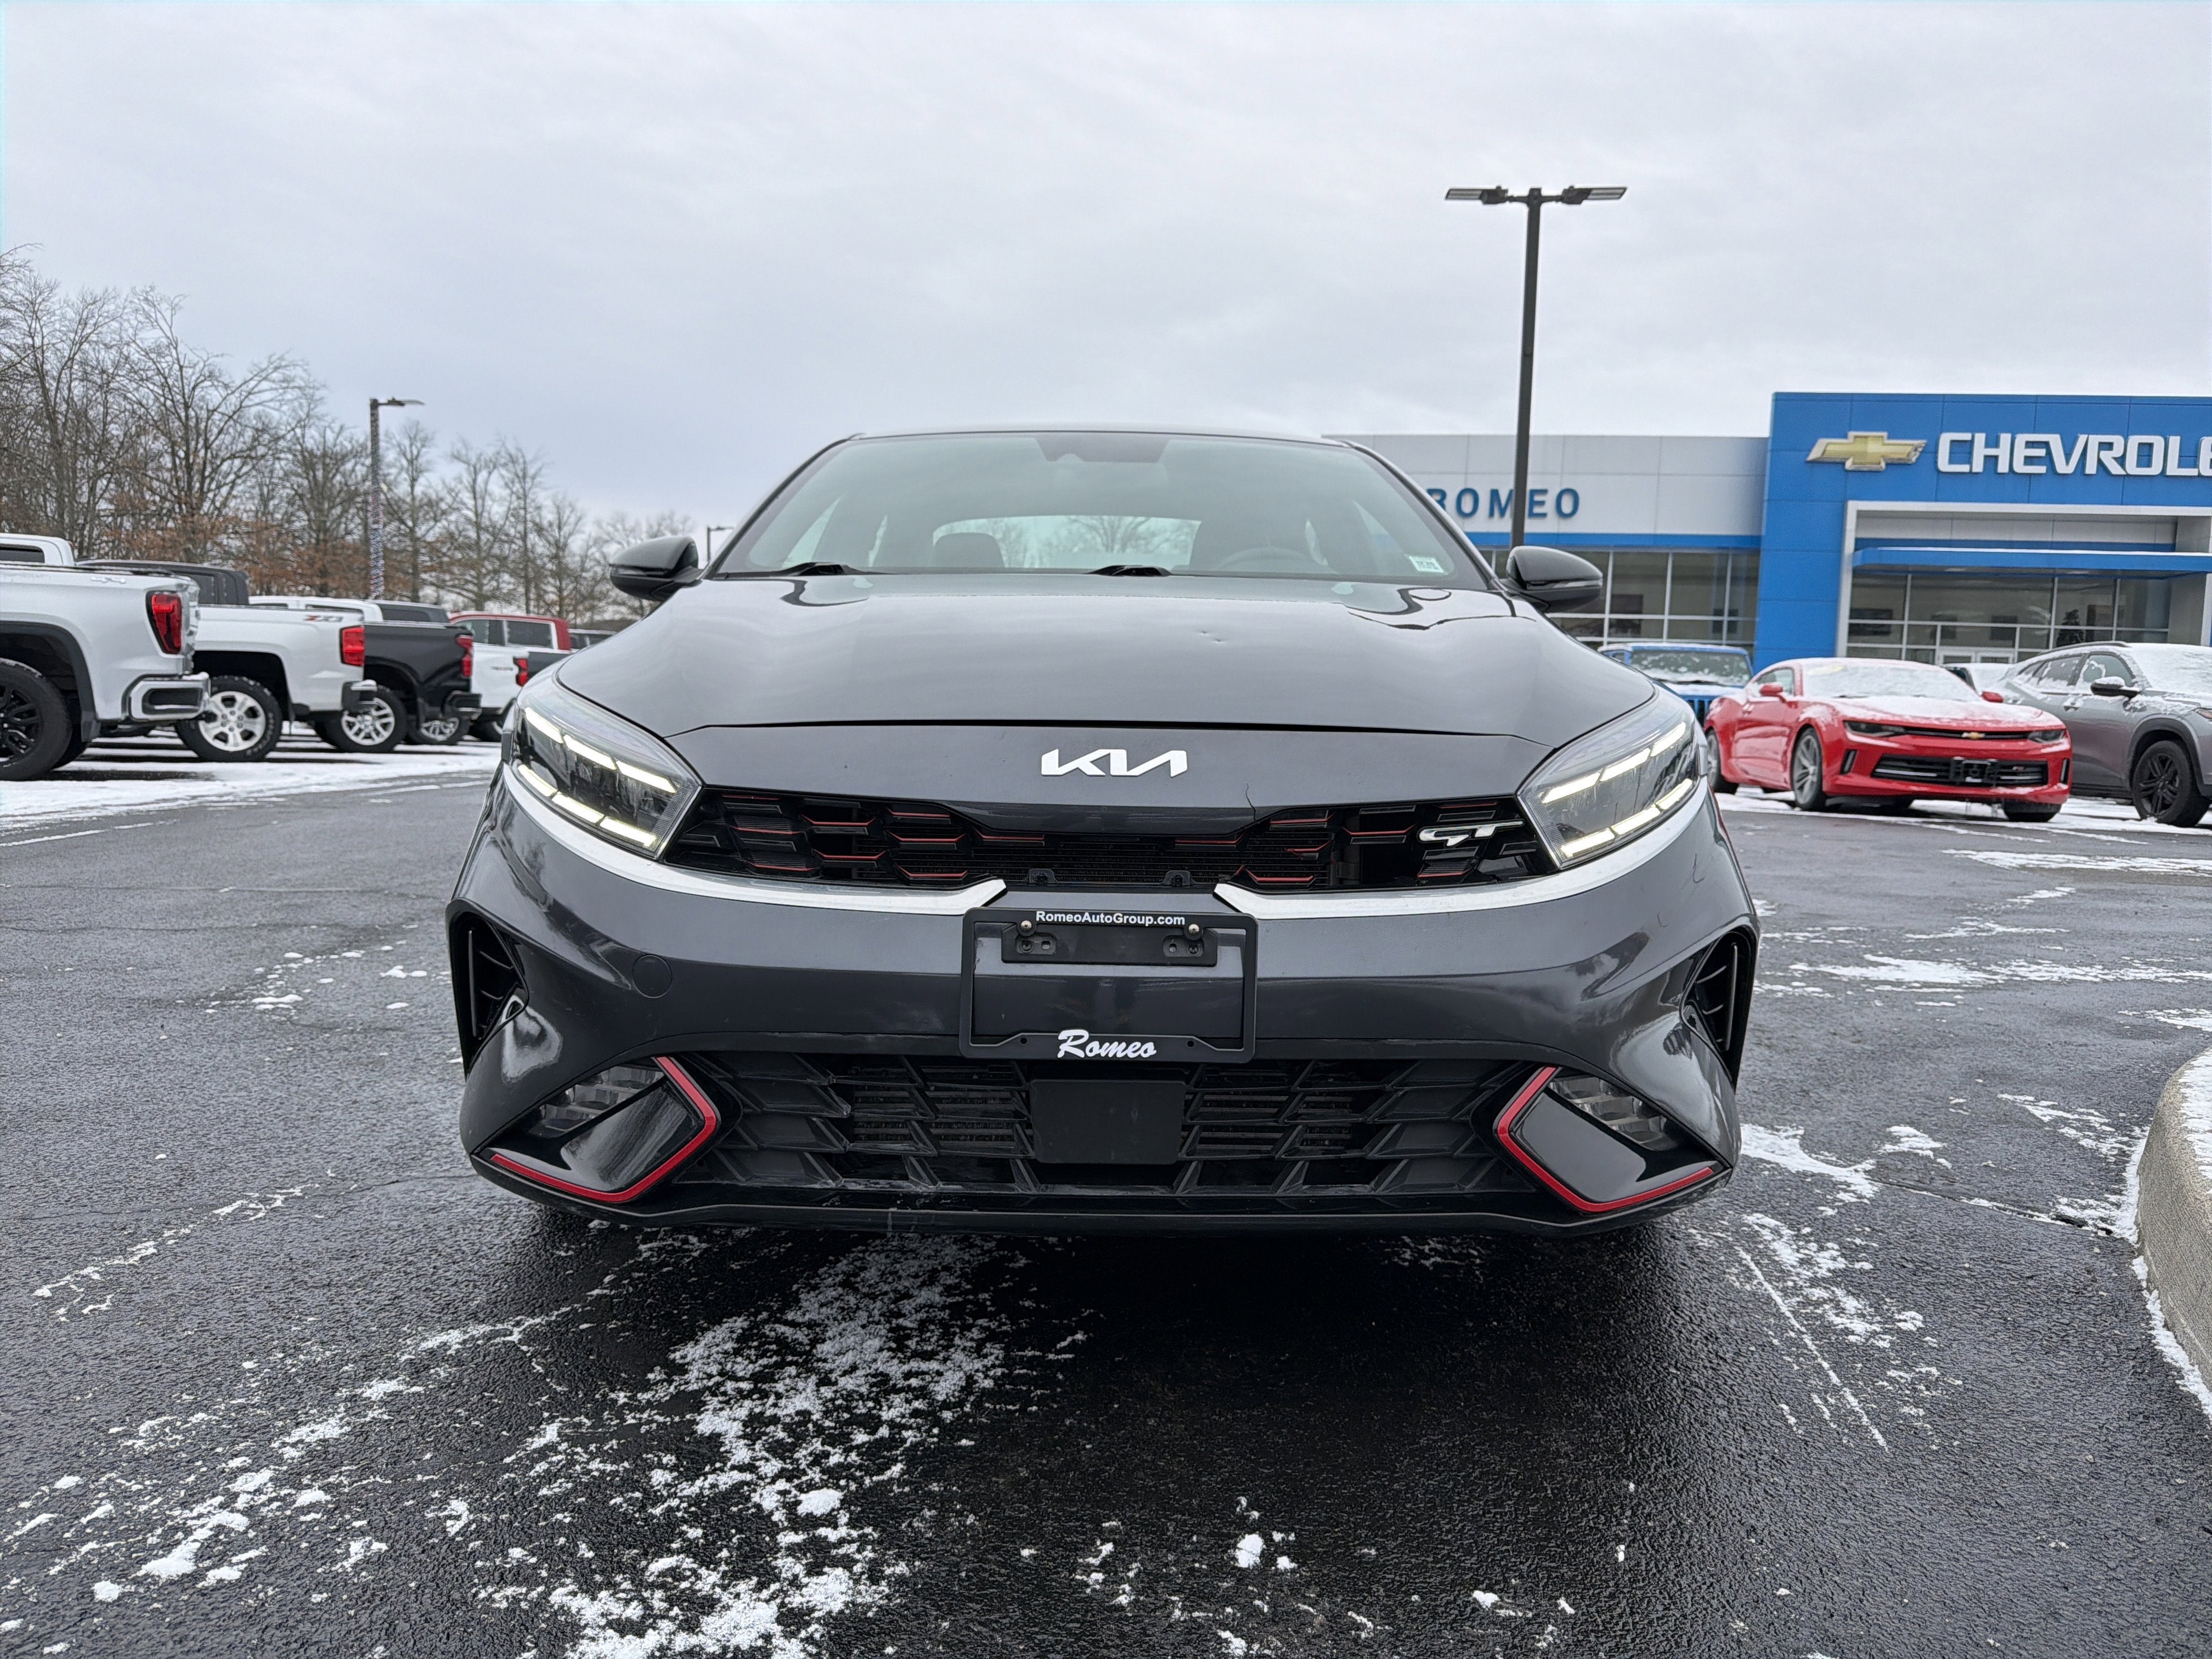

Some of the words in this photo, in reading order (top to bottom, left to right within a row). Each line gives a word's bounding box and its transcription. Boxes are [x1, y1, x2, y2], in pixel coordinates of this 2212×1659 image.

[1041, 748, 1188, 778] KIA
[1419, 821, 1523, 847] GT
[1036, 911, 1186, 927] RomeoAutoGroup.com
[1057, 1029, 1157, 1058] Romeo
